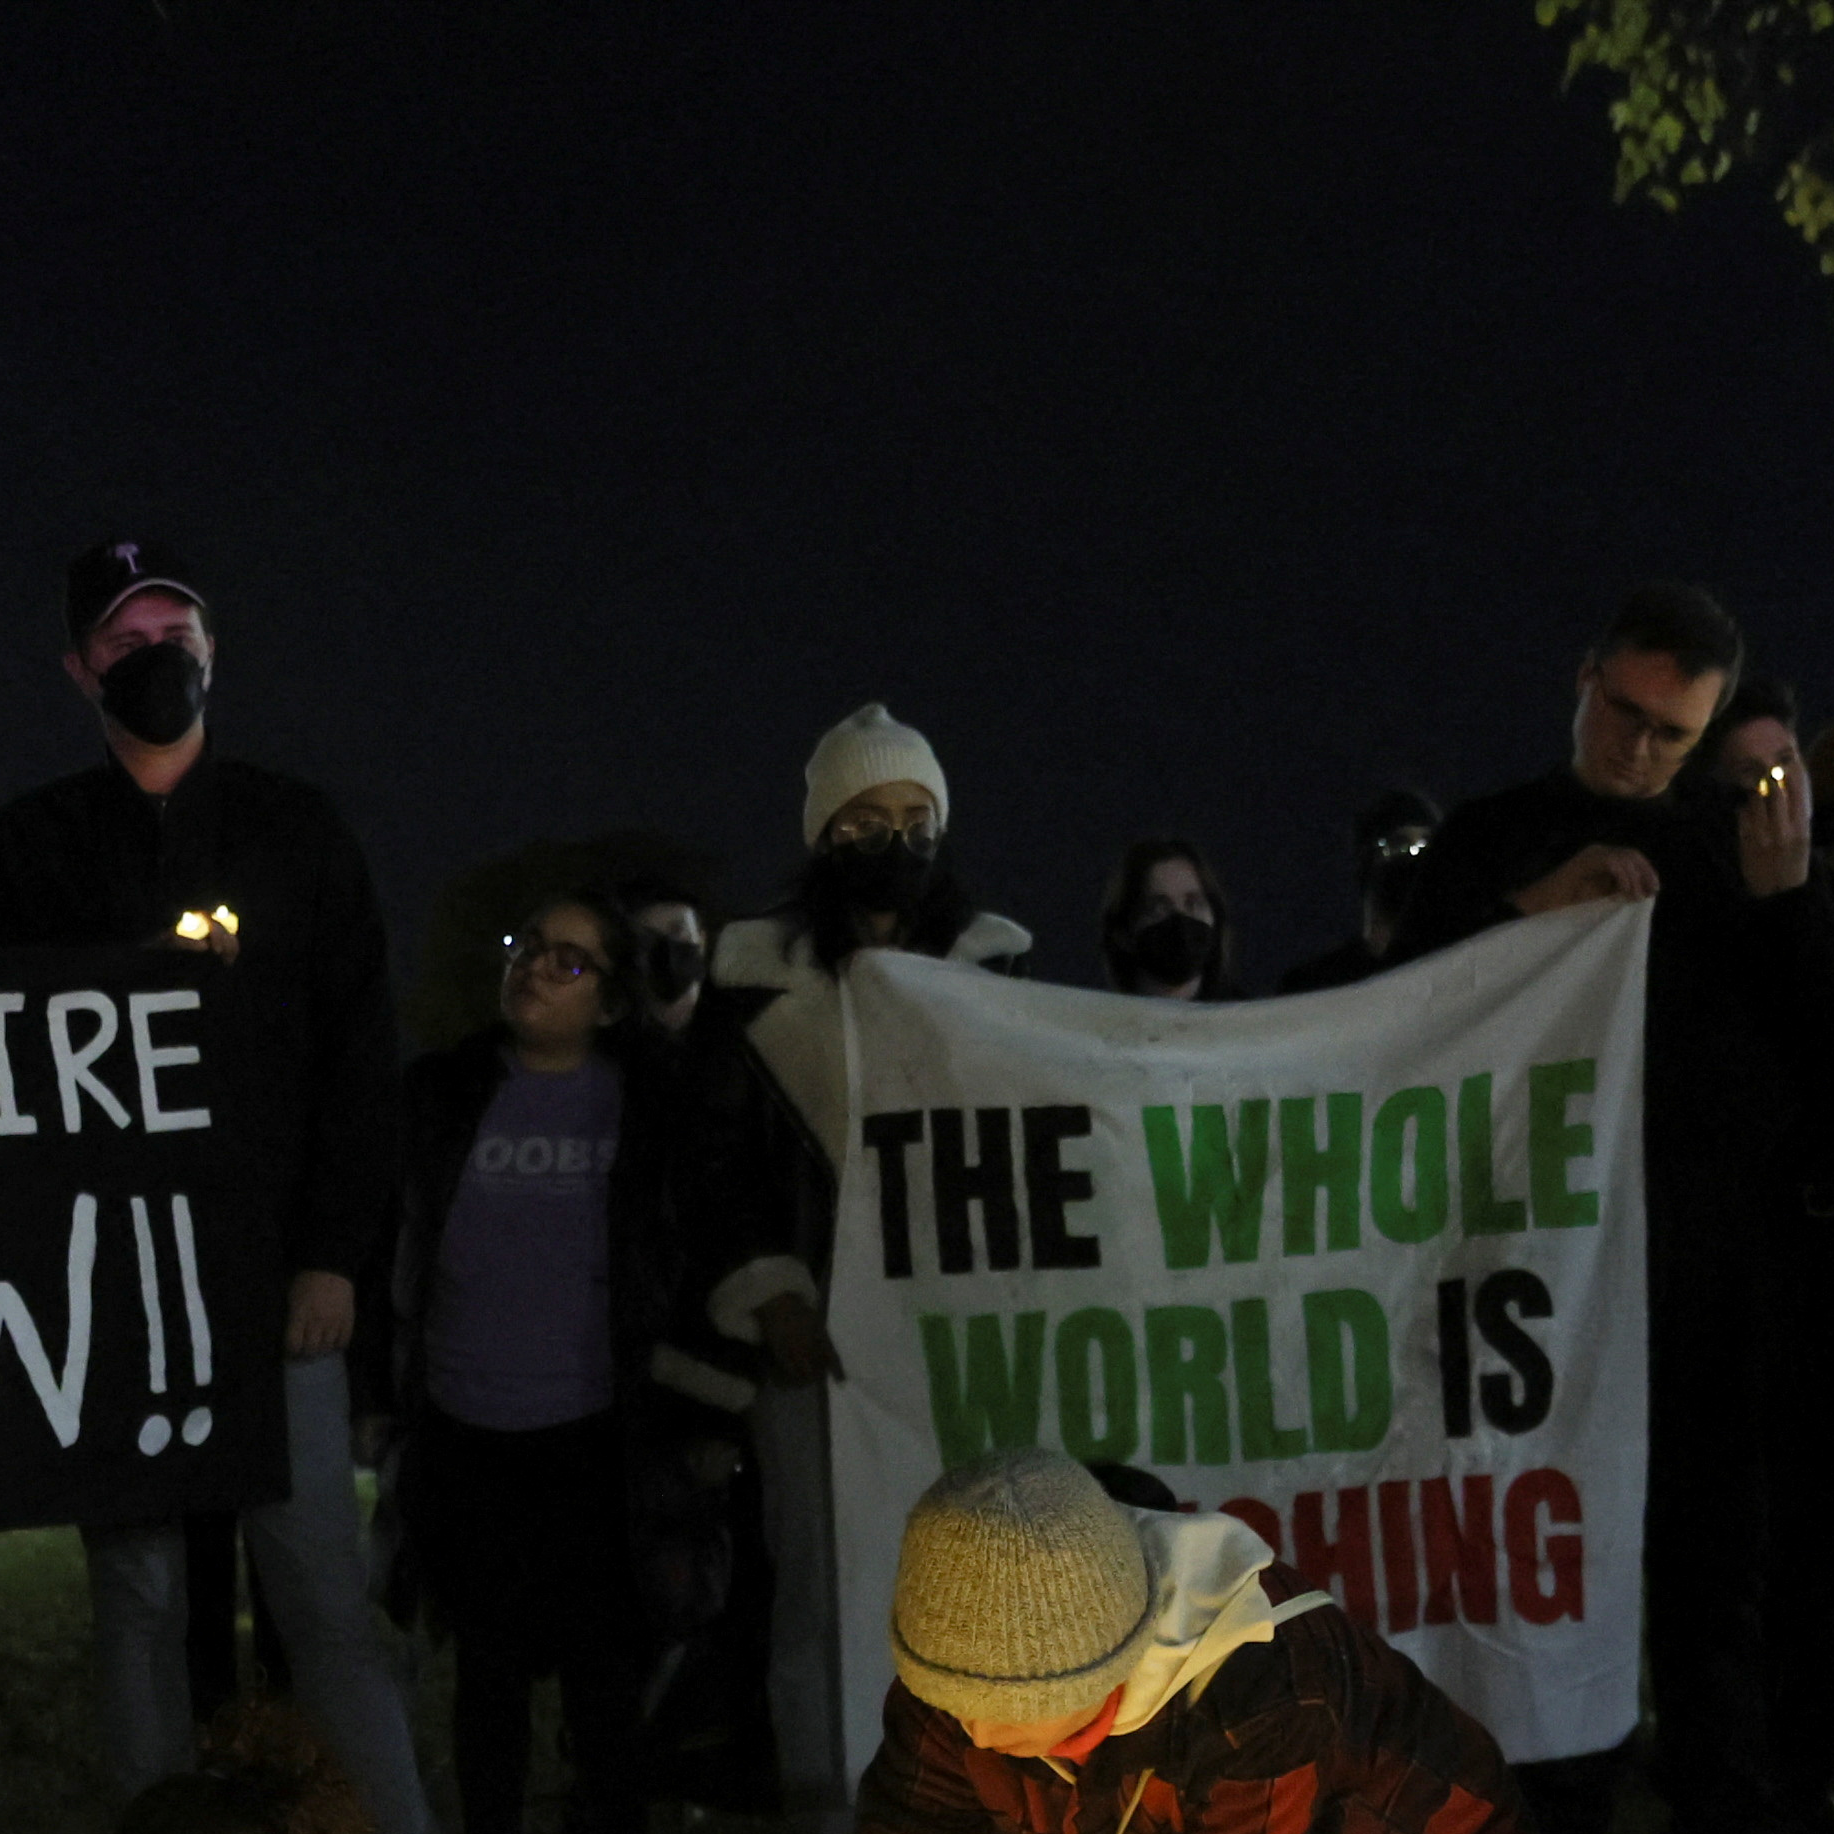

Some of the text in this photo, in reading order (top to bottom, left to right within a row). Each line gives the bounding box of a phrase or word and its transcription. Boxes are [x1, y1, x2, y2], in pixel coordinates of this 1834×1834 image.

[861, 1057, 1600, 1280] THE WHOLE
[917, 1268, 1555, 1472] WORLD IS
